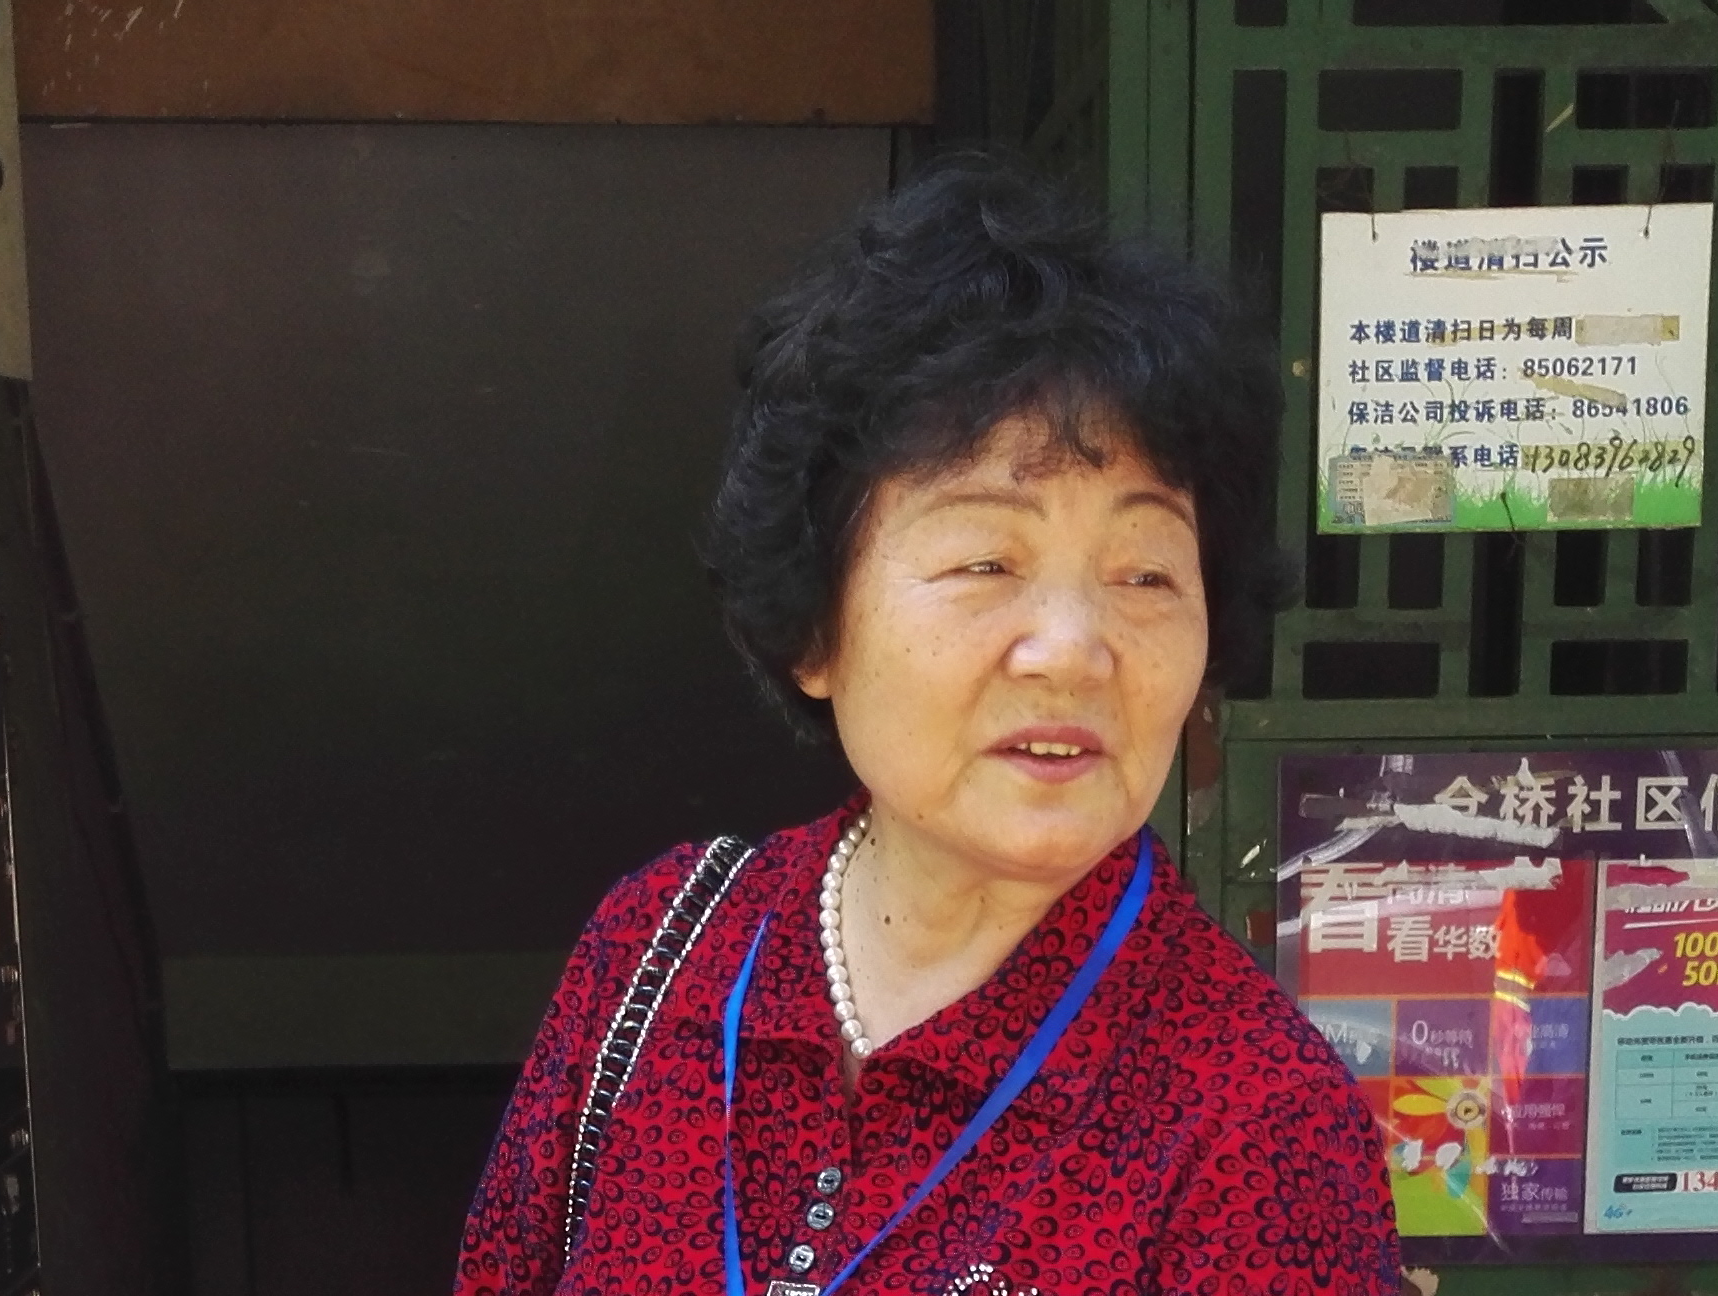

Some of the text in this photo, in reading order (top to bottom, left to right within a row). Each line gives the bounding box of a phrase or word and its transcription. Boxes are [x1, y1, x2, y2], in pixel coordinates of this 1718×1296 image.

[1349, 315, 1574, 344] 本楼道清扫日为每周
